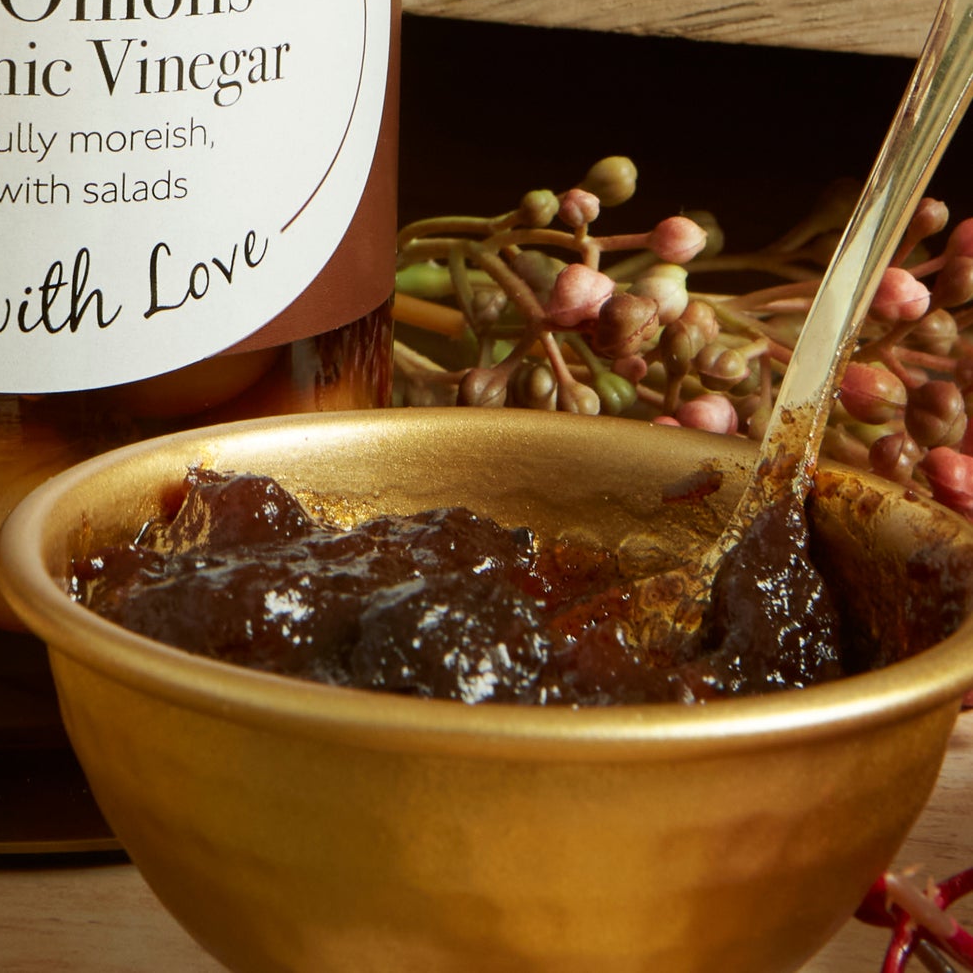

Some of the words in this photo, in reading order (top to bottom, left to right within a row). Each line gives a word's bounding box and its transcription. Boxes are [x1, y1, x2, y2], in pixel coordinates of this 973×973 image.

[86, 38, 290, 107] Vinegar
[70, 117, 214, 153] moreish,
[83, 169, 187, 204] salads
[143, 230, 268, 319] Love
